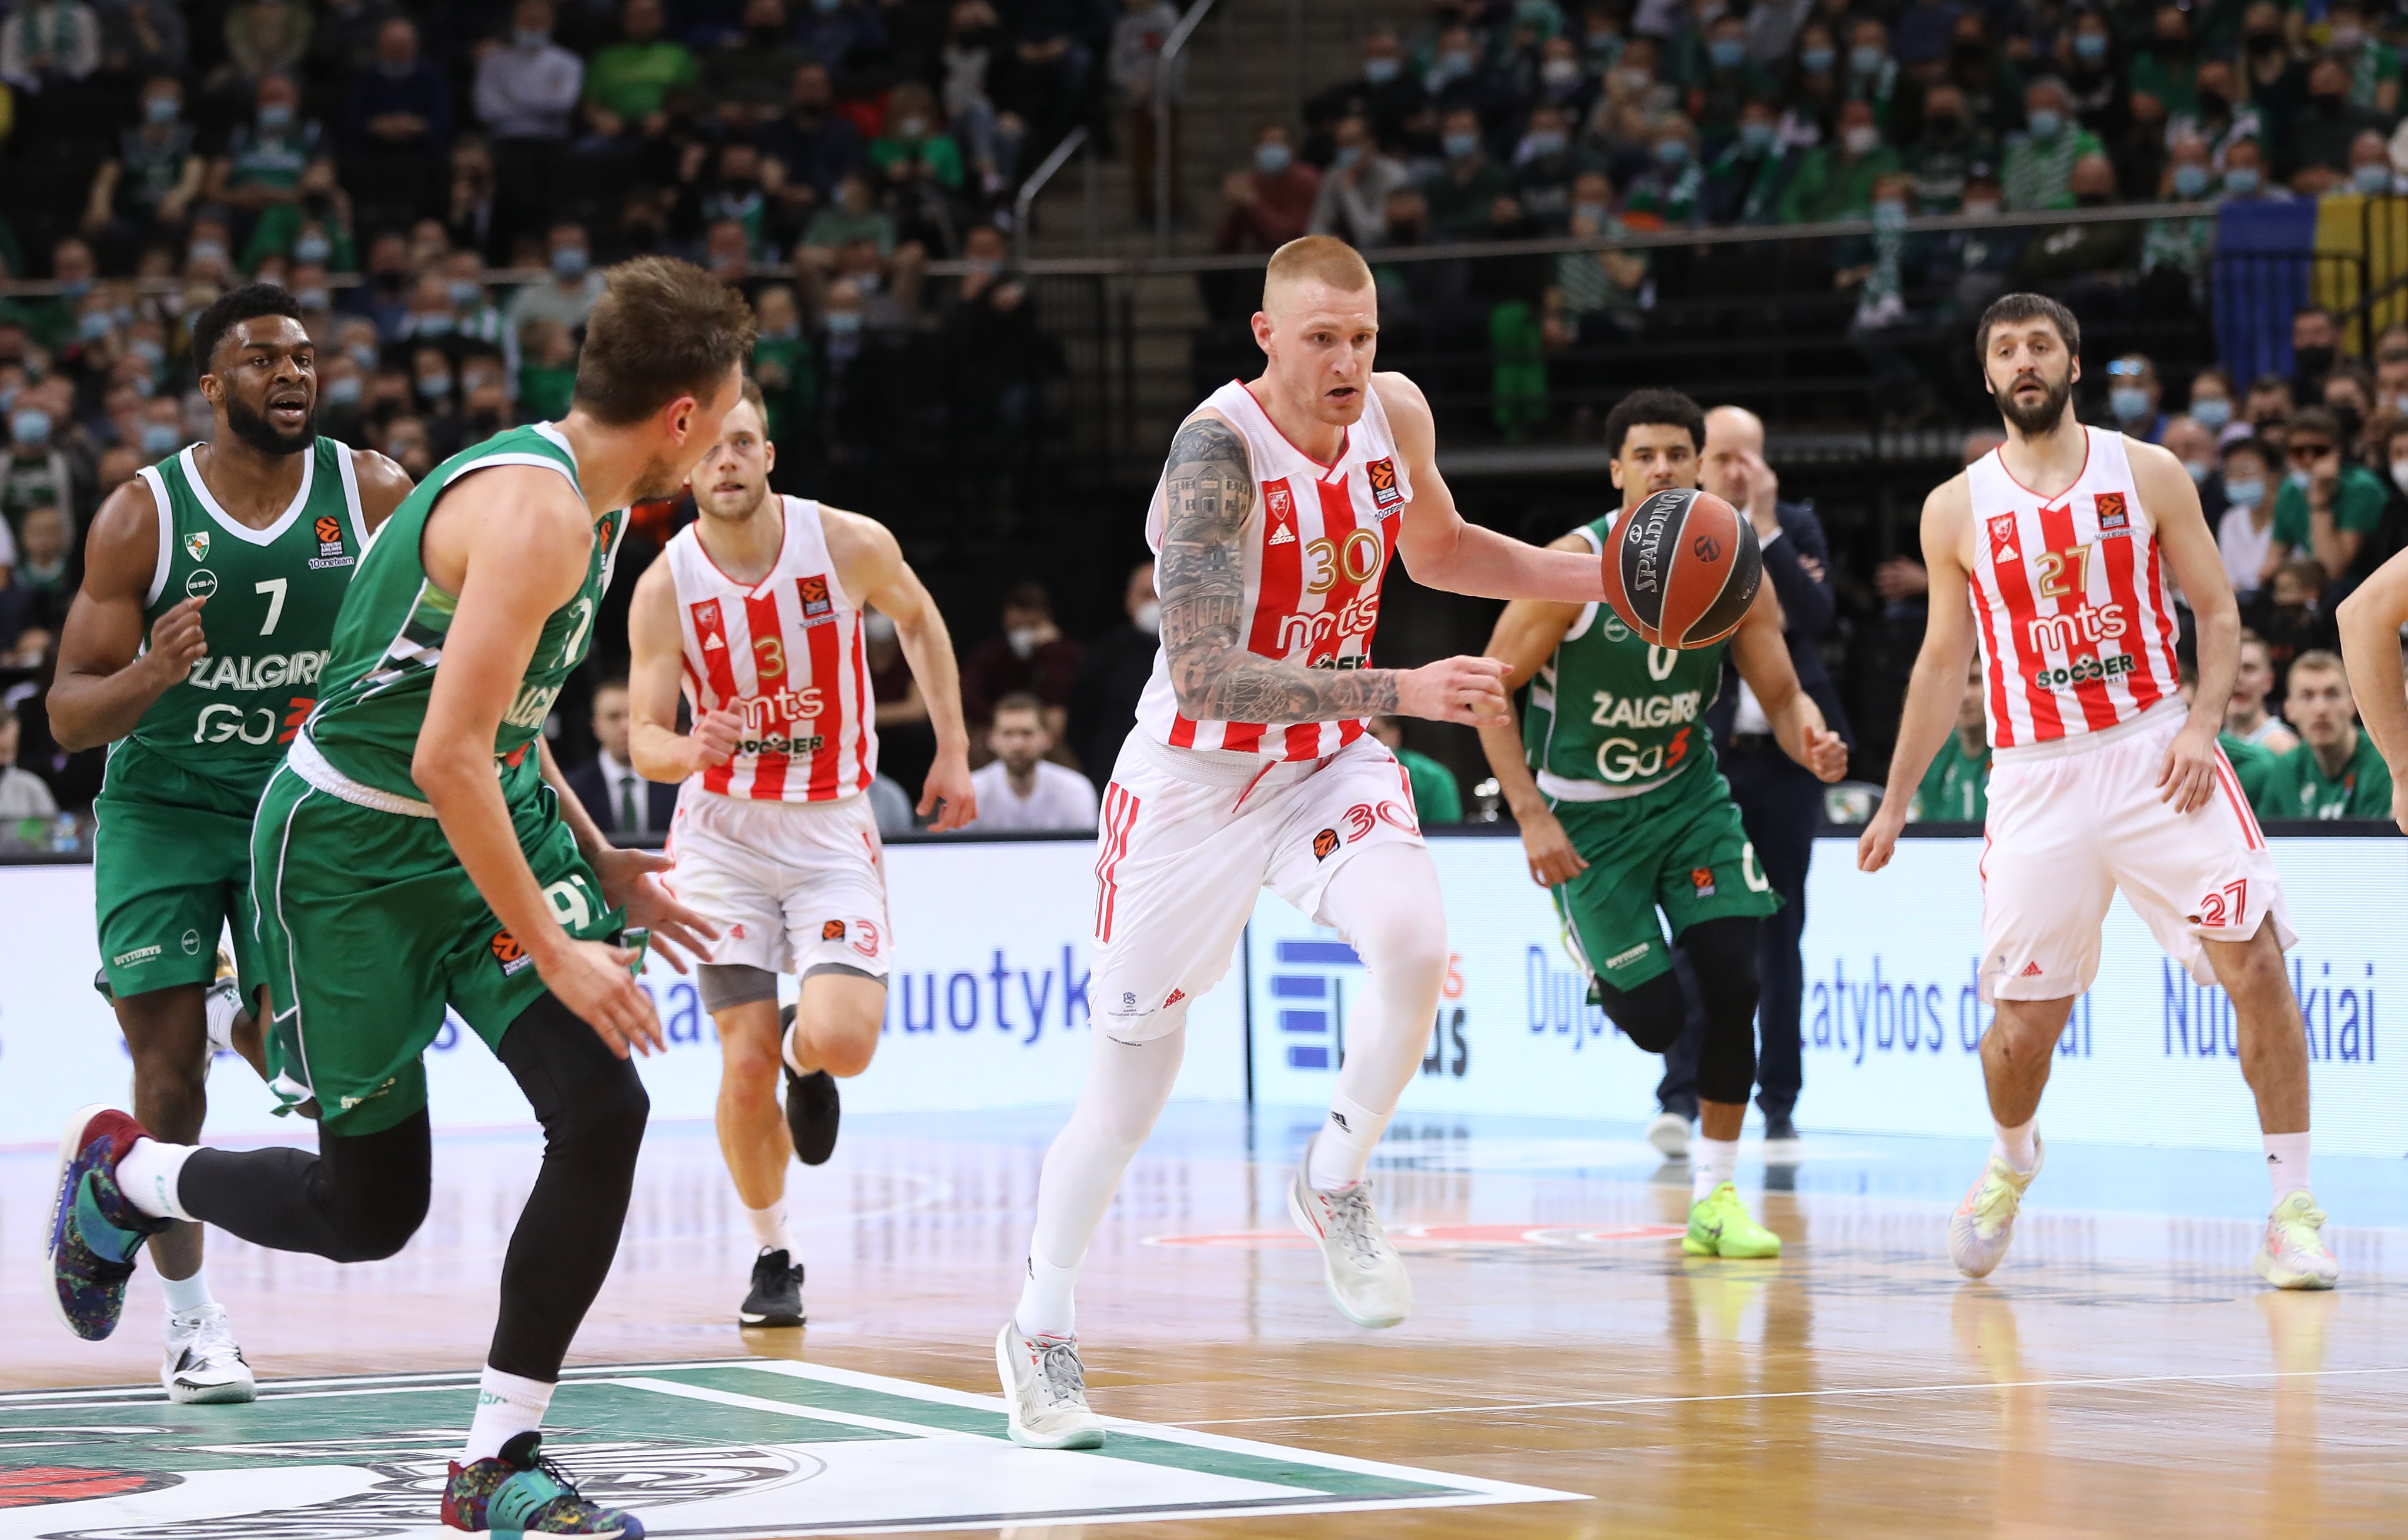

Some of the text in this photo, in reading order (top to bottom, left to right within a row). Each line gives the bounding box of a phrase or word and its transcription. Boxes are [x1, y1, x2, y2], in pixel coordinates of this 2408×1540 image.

[1306, 529, 1382, 594] 30
[1634, 494, 1688, 593] SPALDING
[189, 579, 215, 589] GSA
[2035, 544, 2092, 599] 27
[255, 578, 287, 636] 7
[1276, 594, 1379, 650] mts
[2028, 602, 2127, 653] mts
[755, 636, 785, 679] 3
[2036, 654, 2137, 689] SOCCER
[1340, 800, 1421, 844] 30
[2200, 878, 2247, 927] 27
[853, 920, 878, 958] 3
